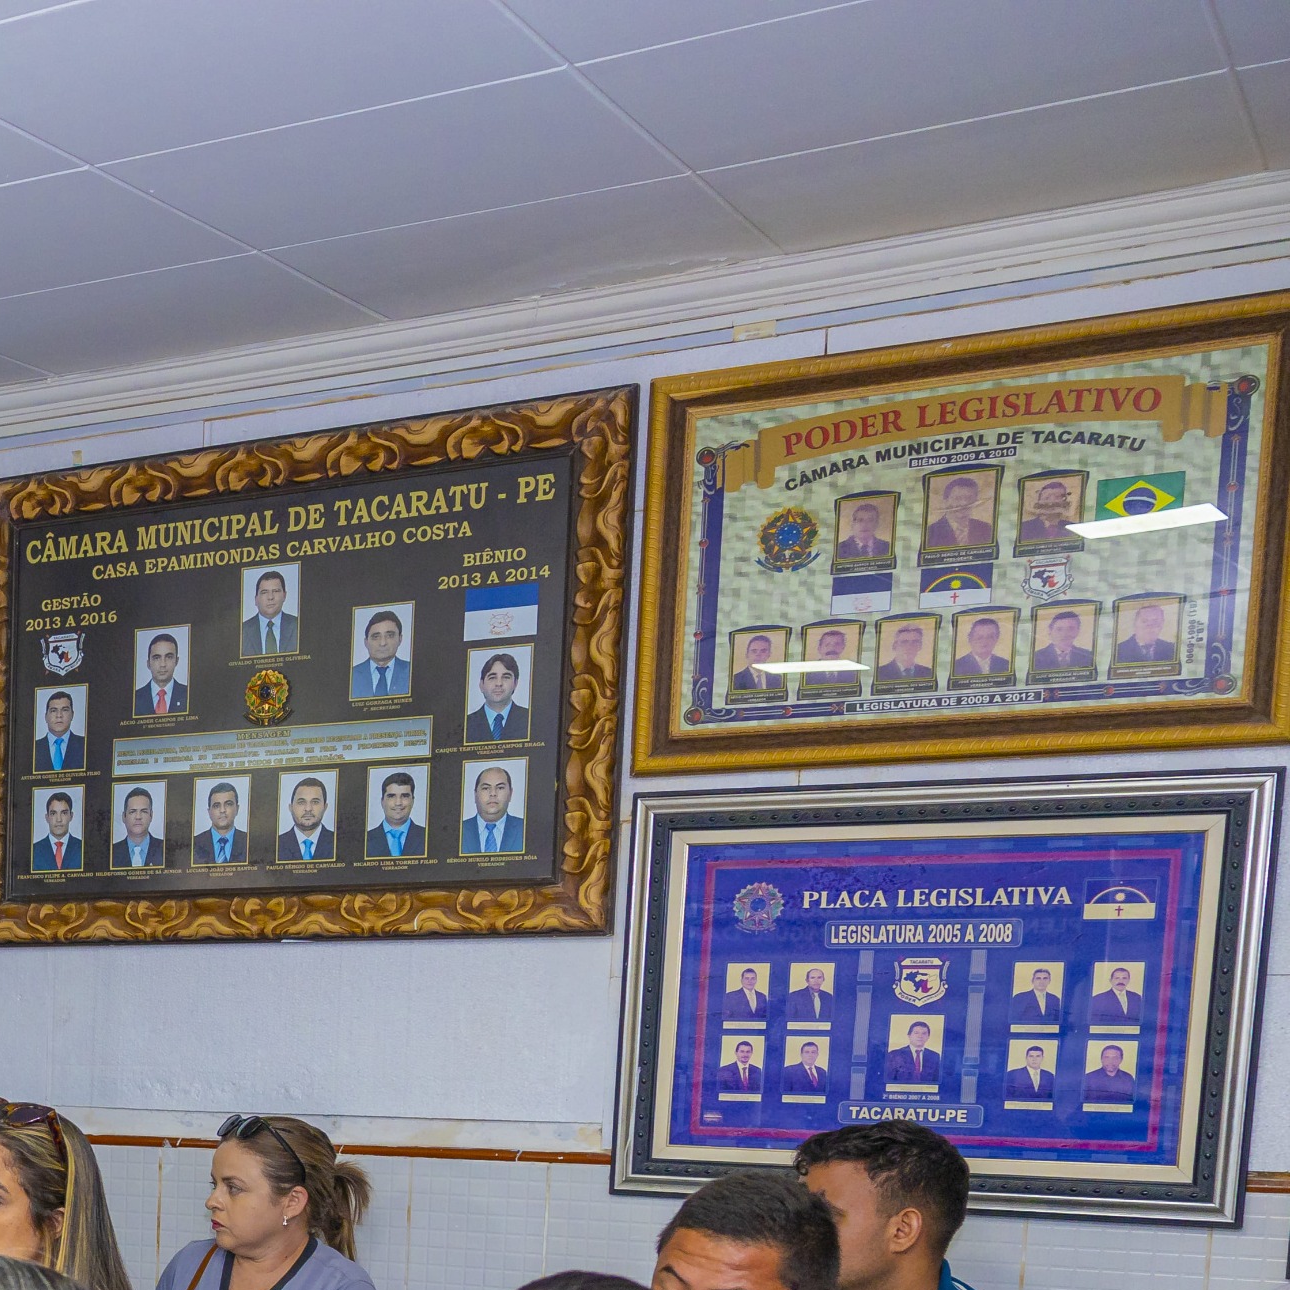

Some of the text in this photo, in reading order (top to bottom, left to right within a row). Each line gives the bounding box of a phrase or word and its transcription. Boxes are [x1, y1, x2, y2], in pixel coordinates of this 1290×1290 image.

[782, 386, 1163, 457] PODER LEGISLATIVO
[785, 430, 1146, 491] CÂMARA MUNICIPAL DE TACARATU
[950, 453, 975, 462] 2009
[989, 448, 1015, 458] 2010
[25, 532, 129, 564] CÂMARA
[136, 509, 280, 551] MUNICIPAL
[287, 503, 325, 532] DE
[334, 482, 489, 527] TACARATU
[517, 473, 556, 503] PE
[92, 520, 472, 580] CASA EPAMINONDAS CARVALHO COSTA
[463, 547, 526, 567] BIÊNIO
[438, 565, 551, 590] 2013 A 2014
[41, 592, 102, 612] GESTÃO
[25, 611, 117, 632] 2013 A 2016
[856, 692, 1035, 711] LEGISLATURA DE 2009 A 2012
[802, 886, 1073, 909] PLACA LEGISLATIVA
[831, 923, 1012, 943] LEGISLATURA 2005 A 2008
[849, 1106, 968, 1123] TACARATU-PE
